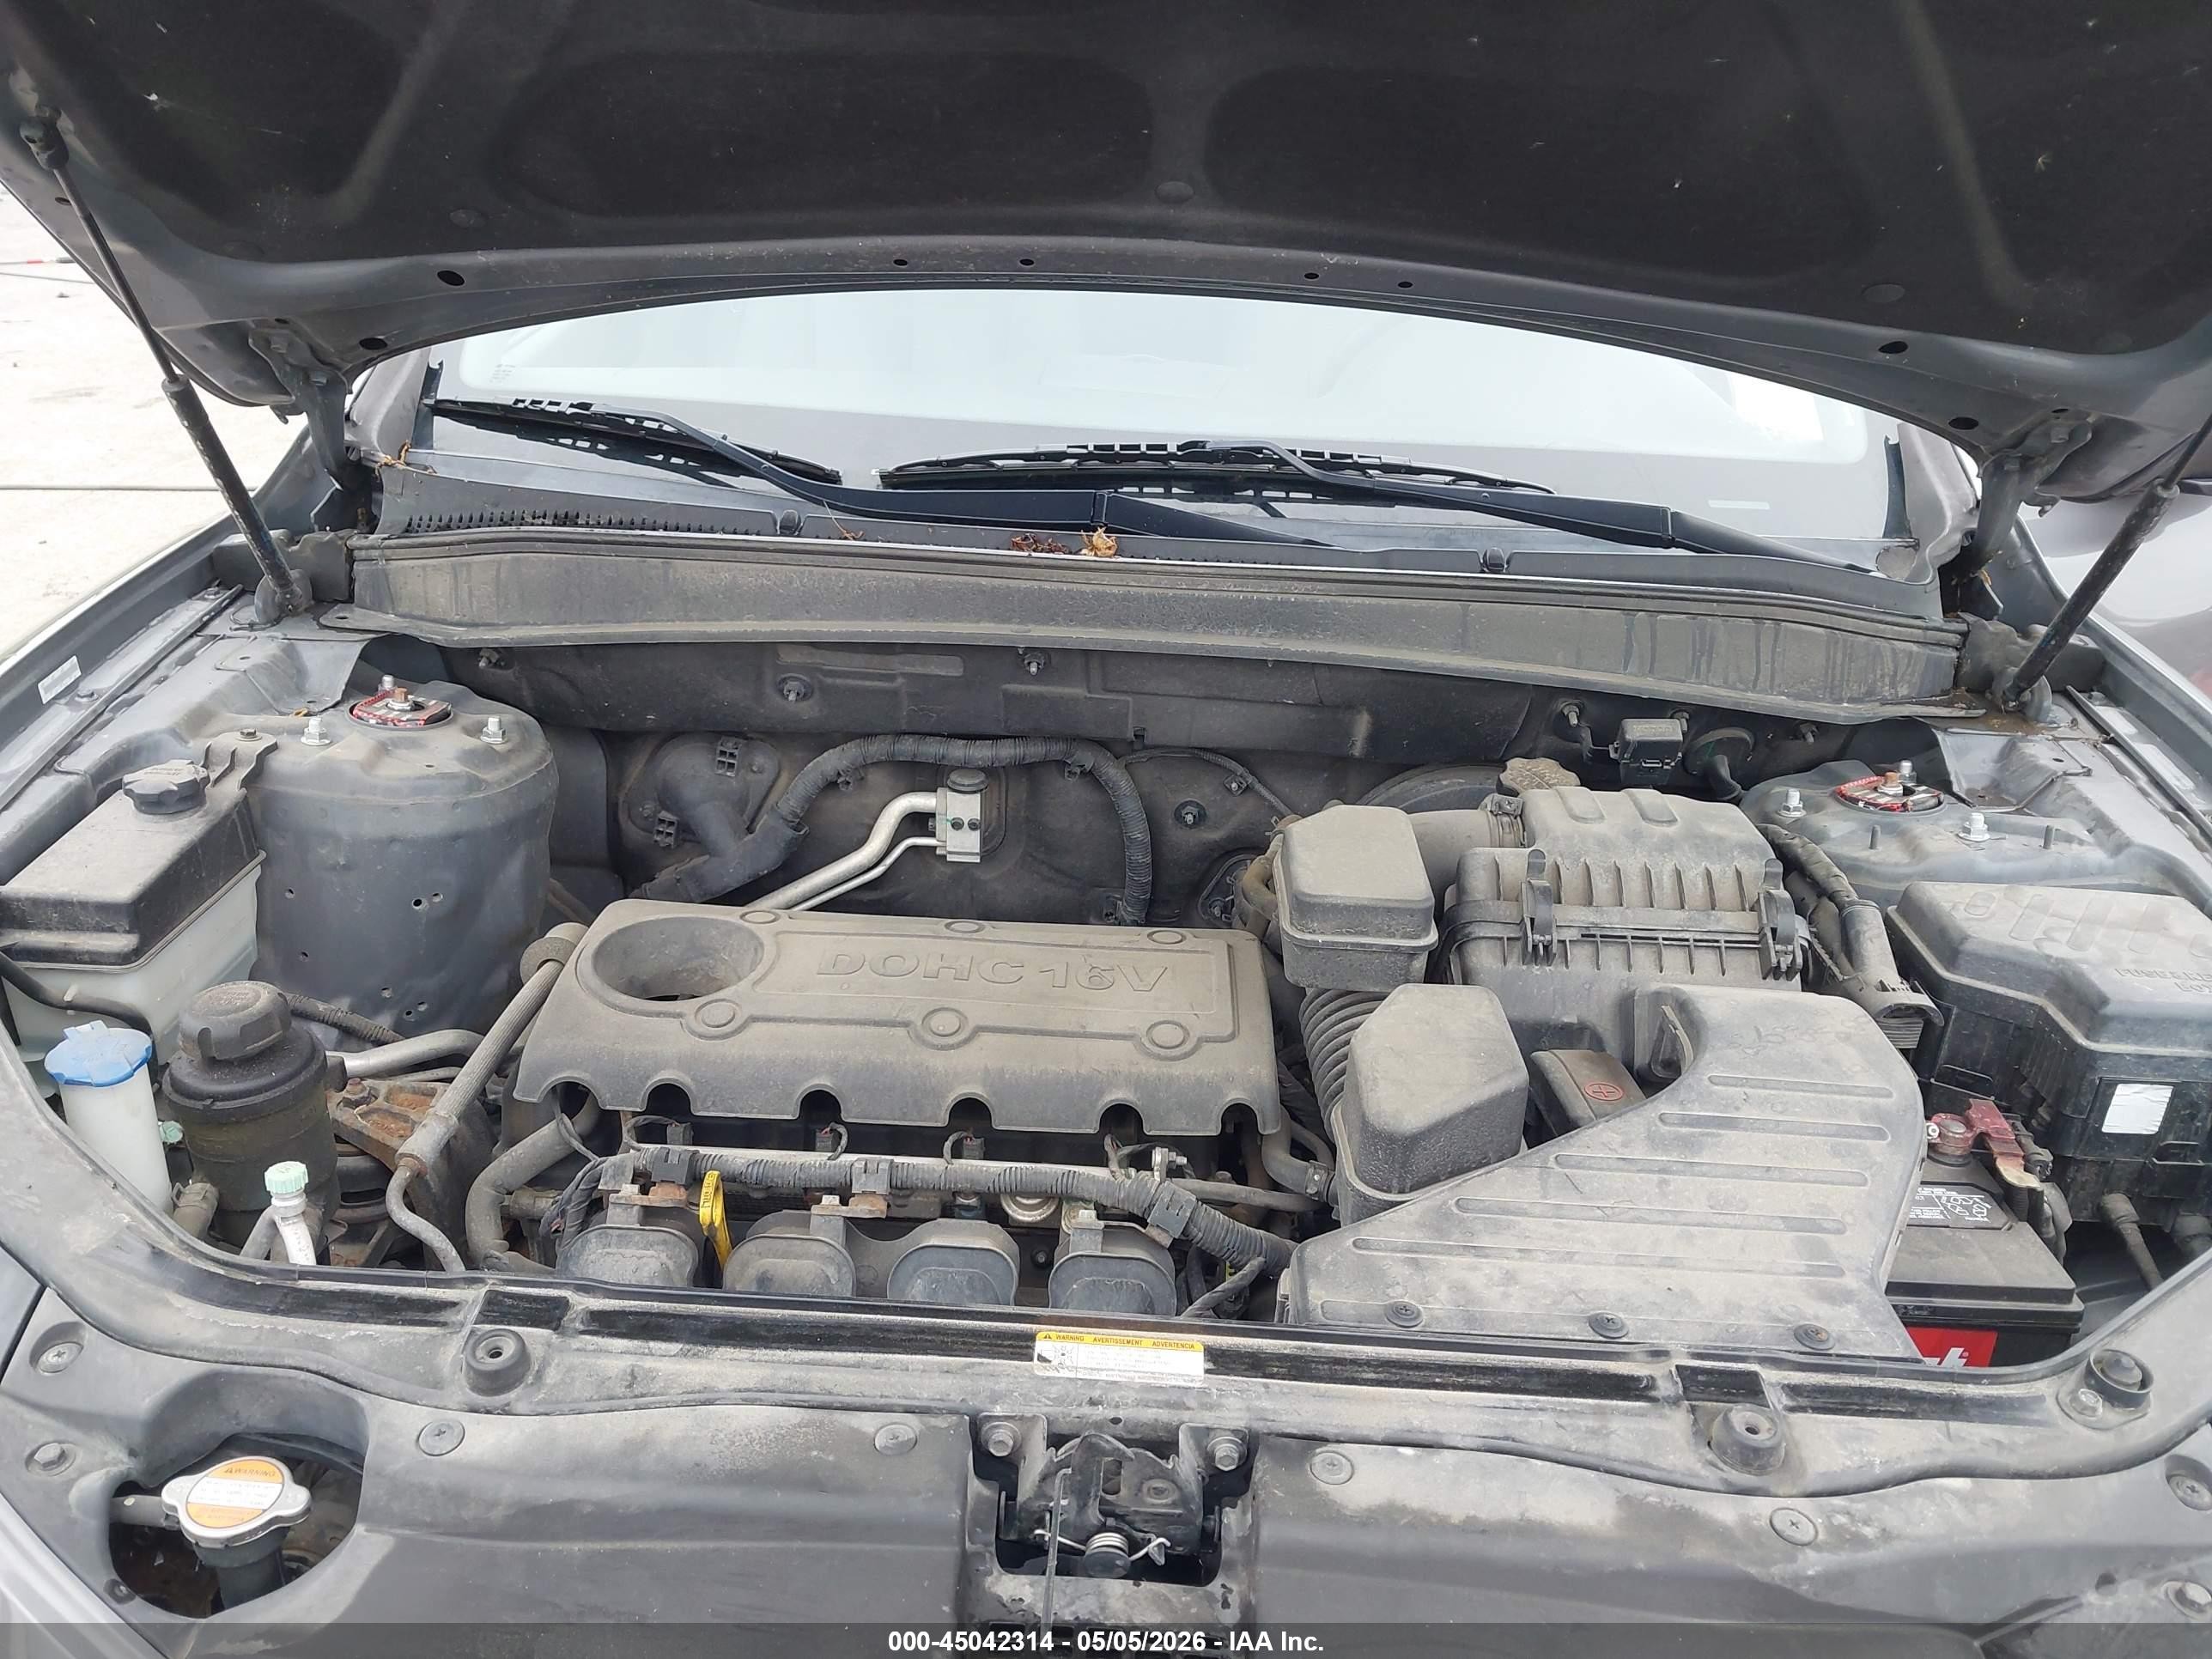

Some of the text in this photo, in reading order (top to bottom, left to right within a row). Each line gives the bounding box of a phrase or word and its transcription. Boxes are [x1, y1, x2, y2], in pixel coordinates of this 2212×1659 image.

[817, 951, 1169, 992] DOHC 16V
[1092, 1337, 1143, 1346] AVERTISSEMENT
[1152, 1340, 1195, 1349] ADVERTENCIA
[234, 1468, 276, 1477] WARNING
